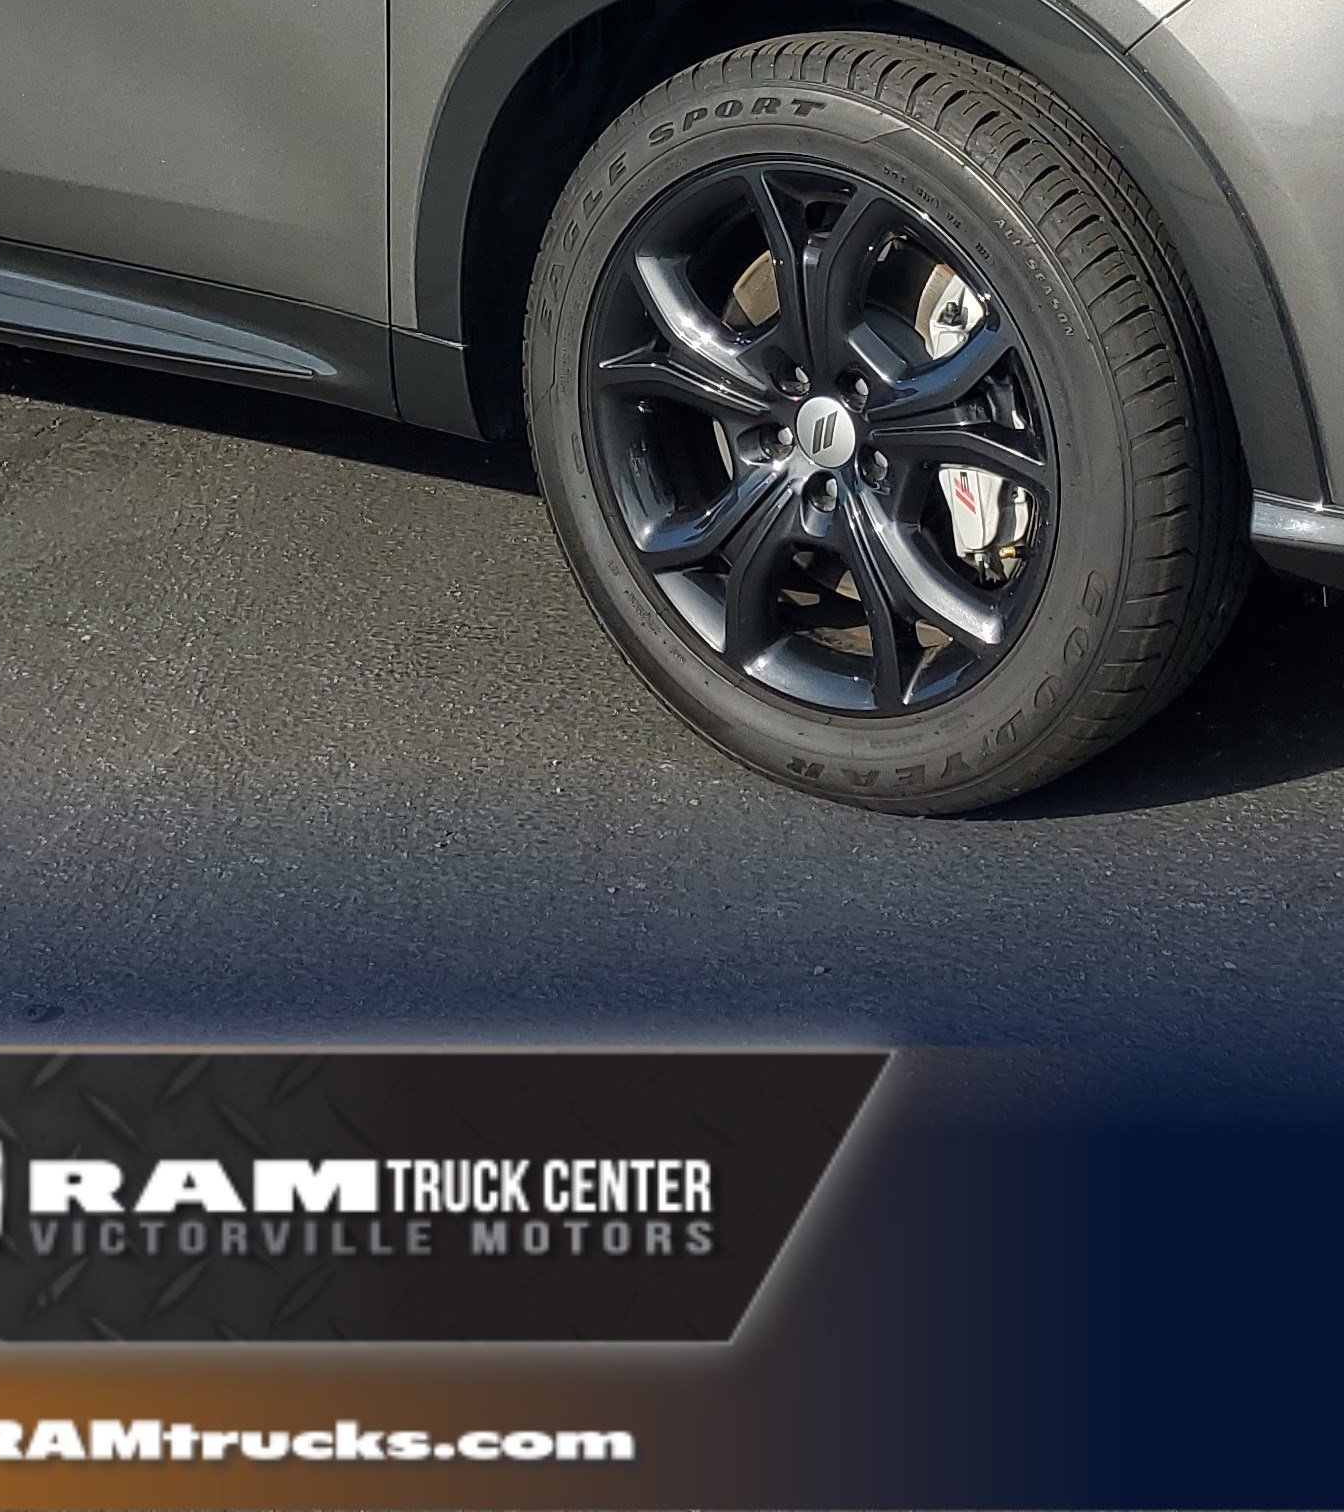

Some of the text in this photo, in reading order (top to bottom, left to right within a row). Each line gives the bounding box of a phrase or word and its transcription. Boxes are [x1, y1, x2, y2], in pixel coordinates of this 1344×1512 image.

[538, 151, 629, 335] EAGLE
[648, 97, 826, 147] SPORT
[1026, 258, 1075, 337] SEASON
